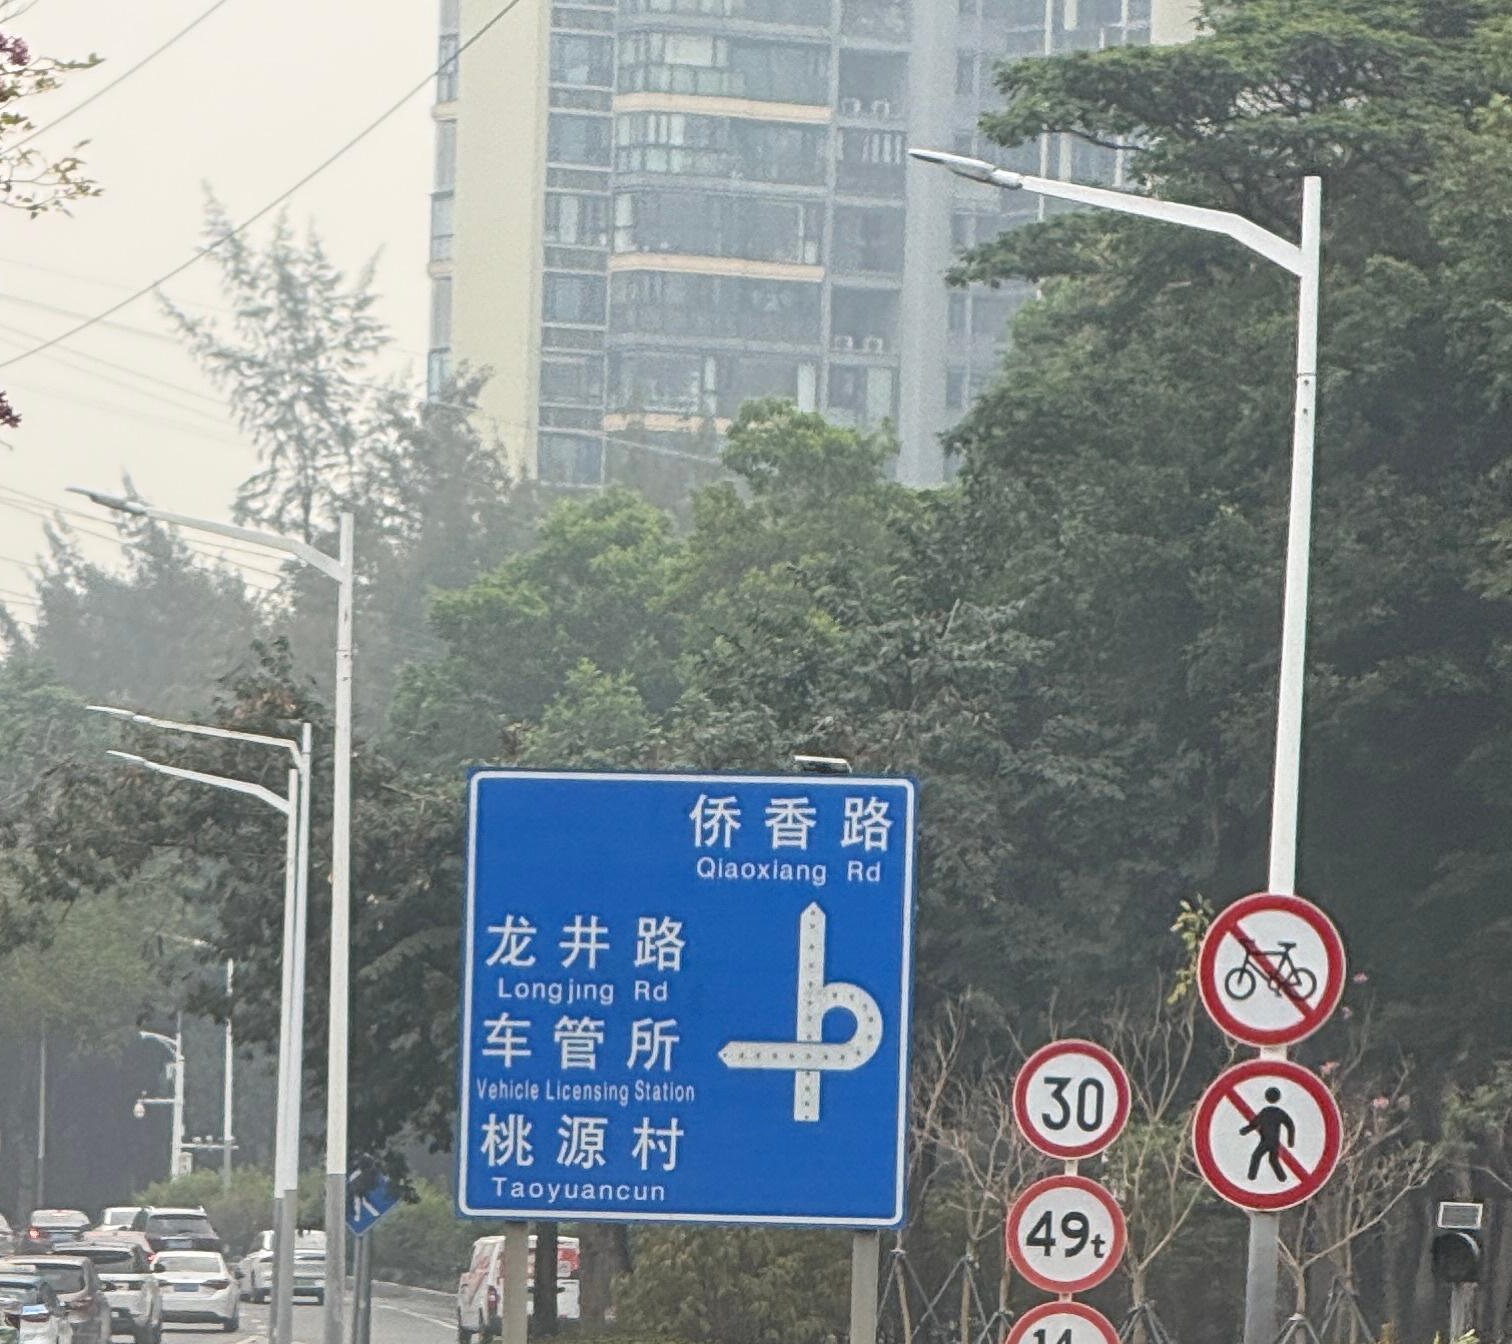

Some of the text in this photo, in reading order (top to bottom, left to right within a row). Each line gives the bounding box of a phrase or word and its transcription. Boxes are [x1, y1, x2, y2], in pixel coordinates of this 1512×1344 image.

[689, 793, 893, 852] 侨香路
[696, 856, 881, 886] Qiaoxiang Rd
[485, 914, 686, 972] 龙井路
[498, 977, 668, 1005] Longjing Rd
[482, 1012, 680, 1072] 车管所
[476, 1077, 696, 1107] Vehicle Licensing Station
[1041, 1076, 1104, 1132] 30
[480, 1113, 685, 1172] 桃源村
[491, 1176, 665, 1203] Taoyuancun
[1026, 1210, 1105, 1258] 49t
